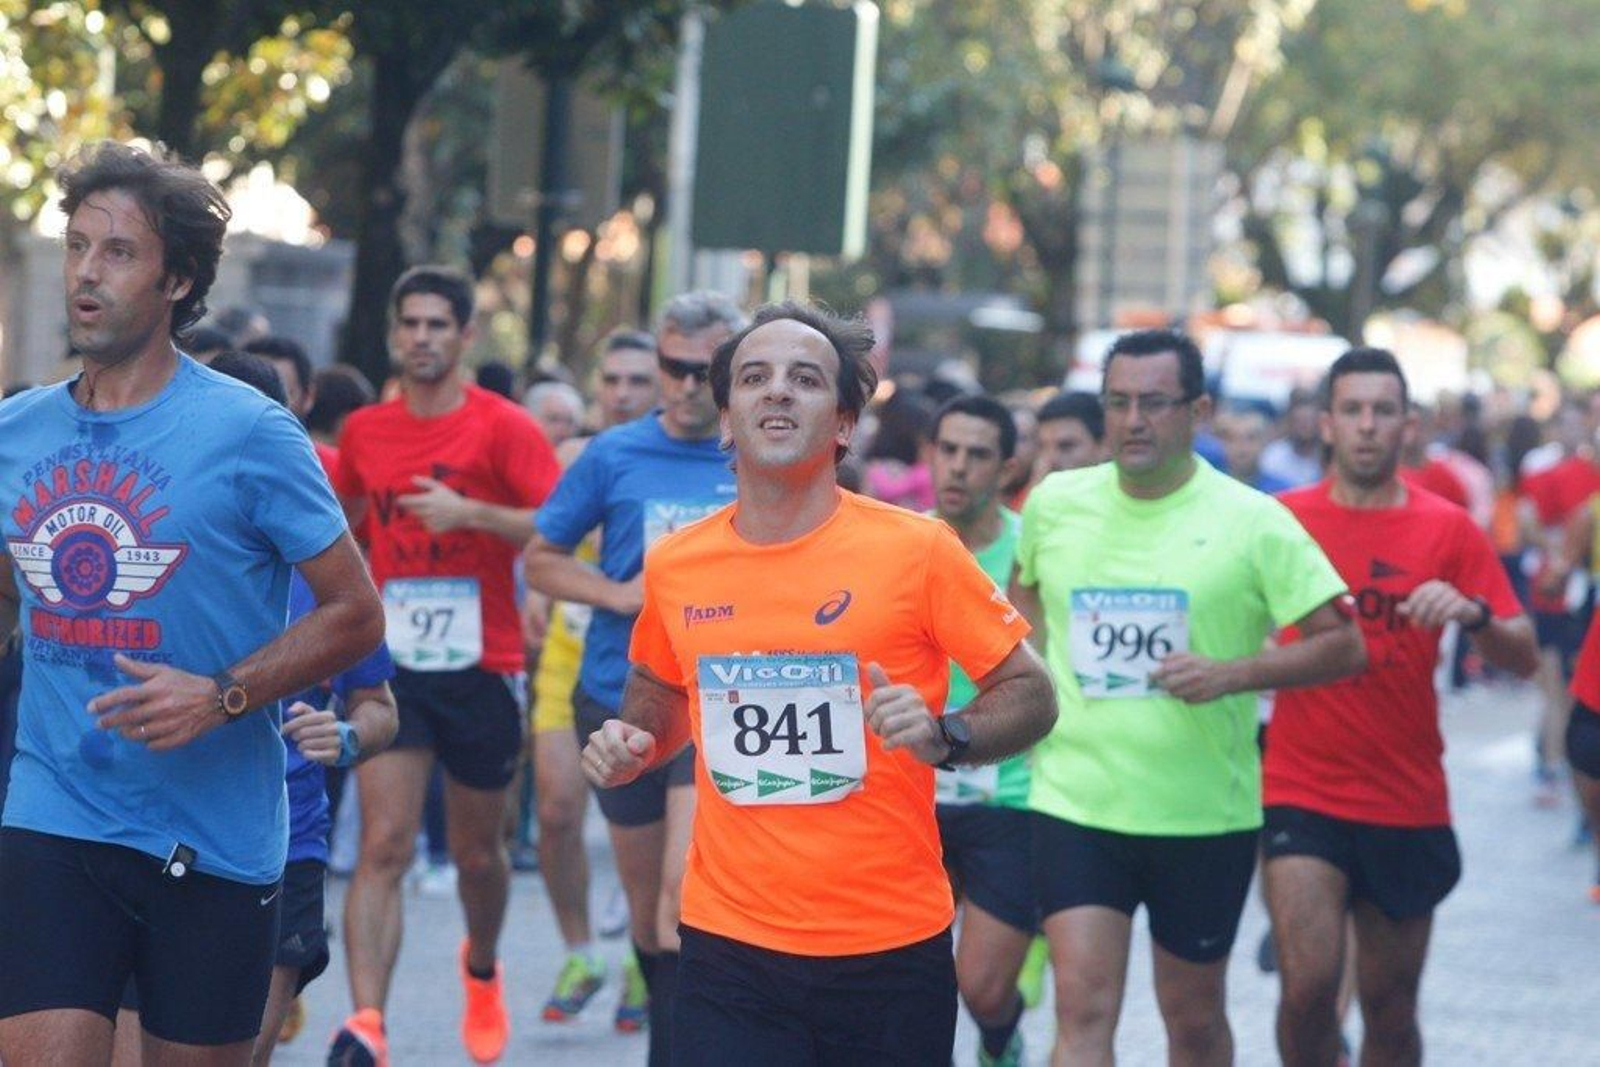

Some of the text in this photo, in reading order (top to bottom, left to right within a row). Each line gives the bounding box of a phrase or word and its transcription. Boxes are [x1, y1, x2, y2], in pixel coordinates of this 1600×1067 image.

[12, 458, 172, 537] MARSHALL
[45, 505, 126, 541] MOTOR OIL
[126, 550, 161, 562] 1943
[410, 607, 454, 640] 97
[1092, 623, 1173, 662] 996
[733, 702, 844, 757] 841
